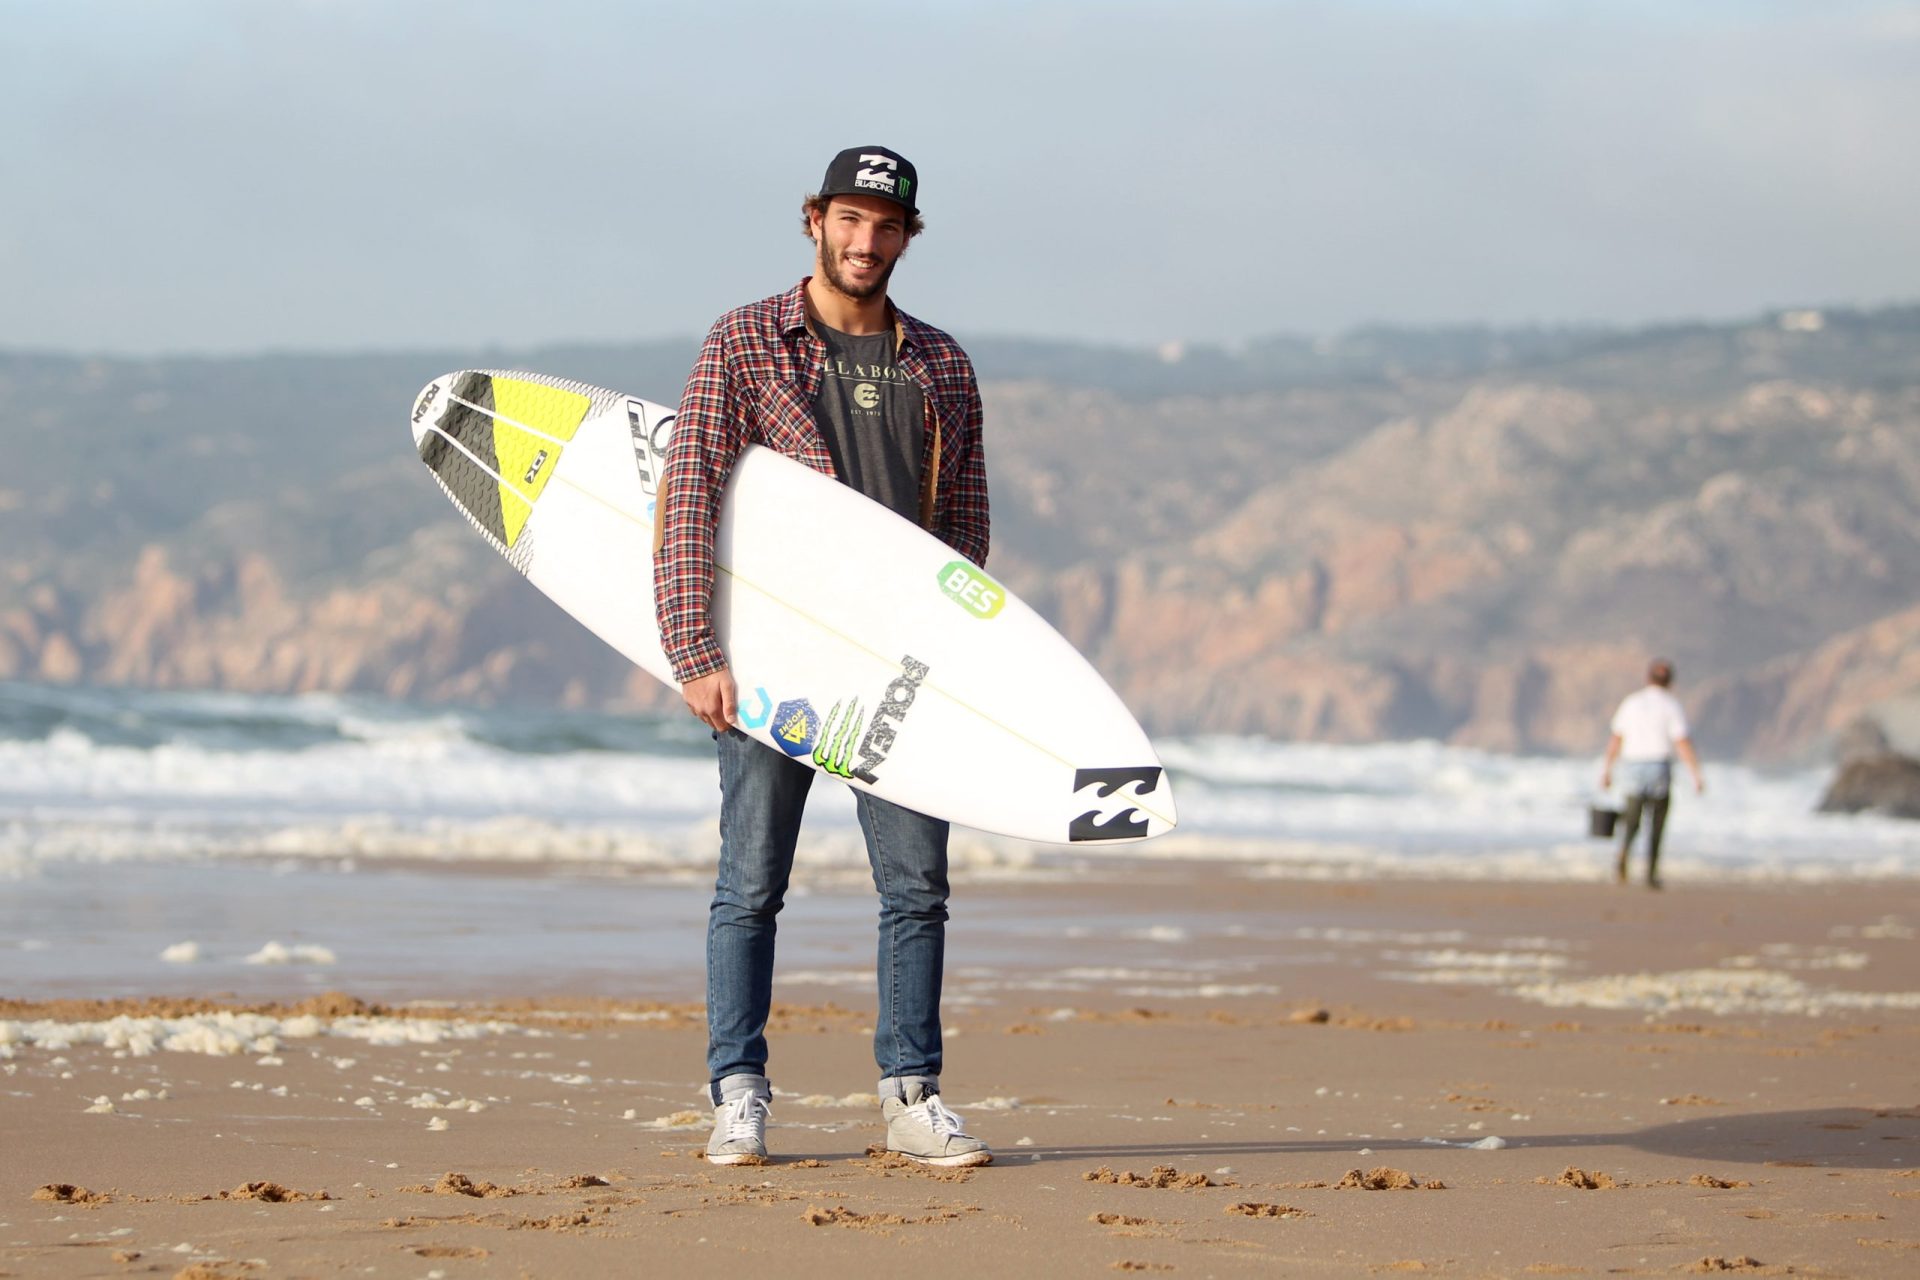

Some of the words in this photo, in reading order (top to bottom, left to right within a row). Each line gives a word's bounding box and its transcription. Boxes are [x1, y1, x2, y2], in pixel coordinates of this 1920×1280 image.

[854, 179, 894, 194] BILLABONG
[412, 383, 440, 424] POLEN
[945, 568, 999, 614] BES
[778, 707, 805, 737] MOCHE
[852, 654, 930, 786] POLEN
